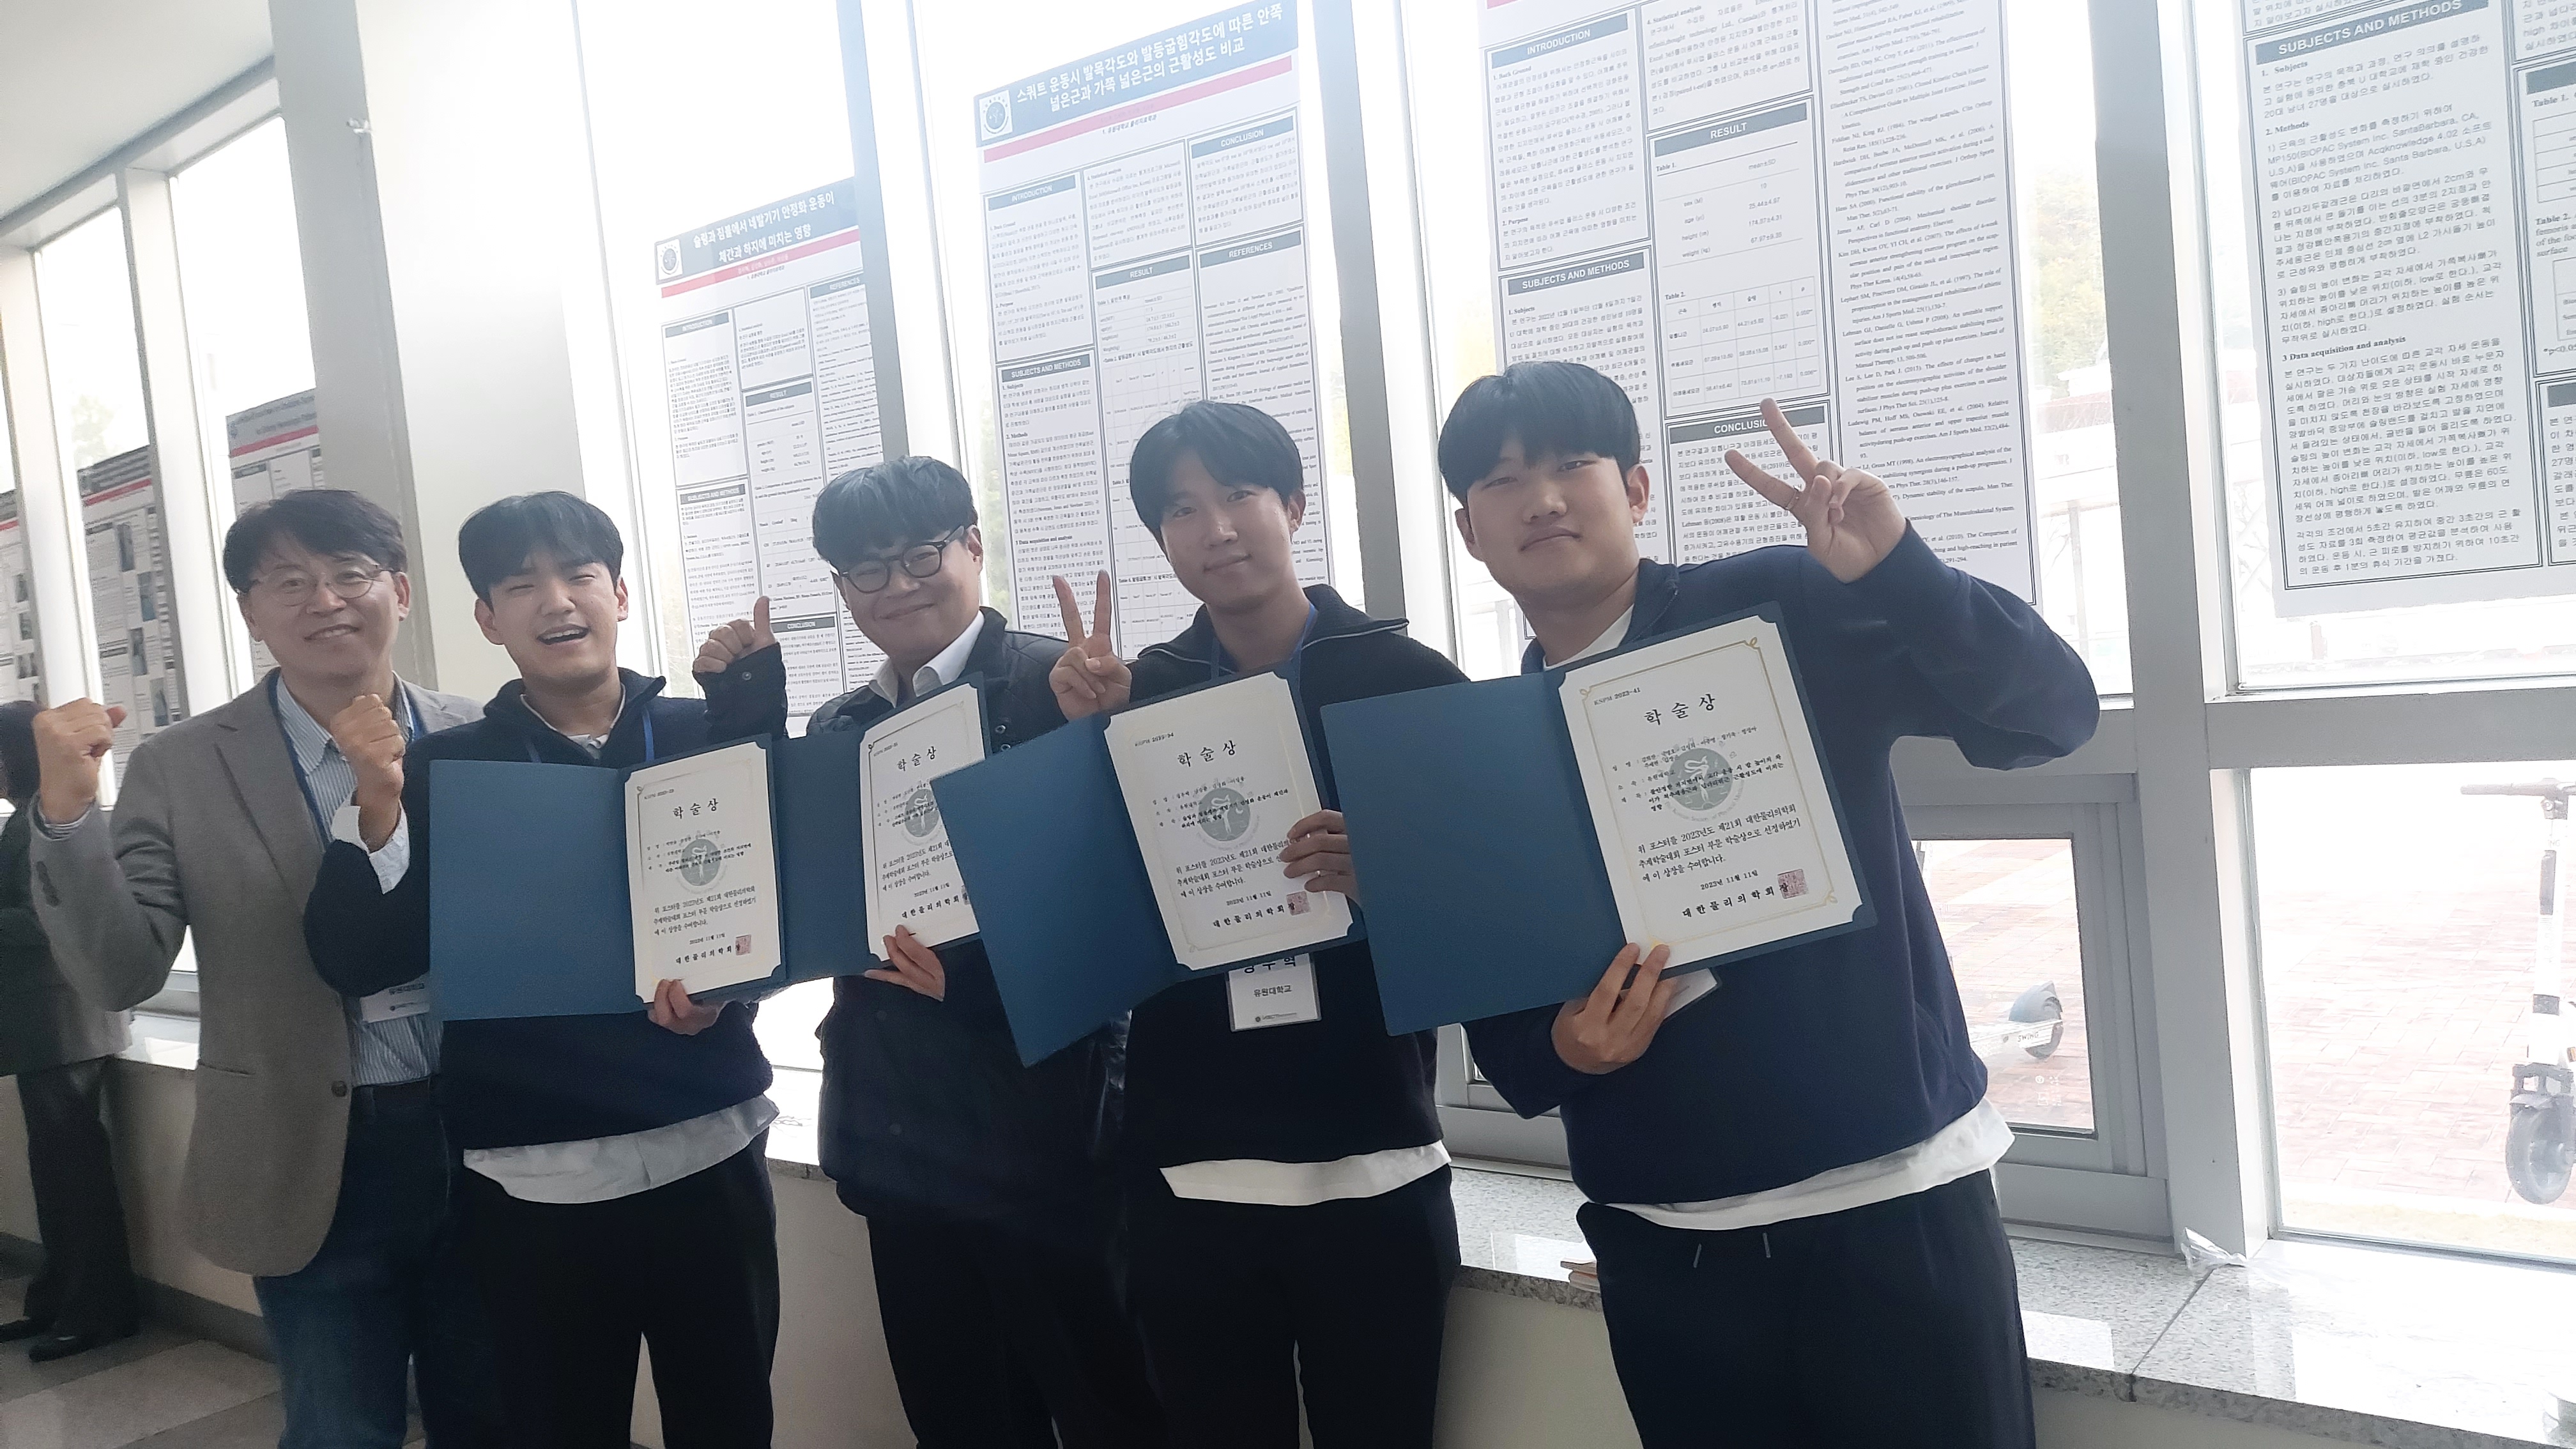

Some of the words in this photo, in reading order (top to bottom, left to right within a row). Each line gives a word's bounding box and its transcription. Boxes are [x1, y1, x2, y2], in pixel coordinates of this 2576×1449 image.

[1653, 10, 1679, 24] Statistical
[1680, 4, 1702, 15] analysis
[2278, 27, 2351, 55] SUBJECTS
[2354, 20, 2384, 37] AND
[2388, 0, 2463, 27] METHODS
[1527, 29, 1590, 54] INTRODUCTION
[1016, 81, 1047, 103] 스쿼트
[1049, 68, 1080, 93] 운동시
[1083, 50, 1138, 81] 발목각도와
[1141, 22, 1225, 62] 발등굽힘각도에
[1228, 13, 1254, 33] 따른
[1257, 3, 1282, 26] 안쪽
[1050, 84, 1091, 112] 넓은근과
[1094, 76, 1116, 95] 가쪽
[1119, 61, 1165, 89] 넓은근의
[1169, 46, 1216, 73] 근활성도
[1220, 36, 1245, 56] 비교
[2274, 61, 2308, 73] Subjects
[2533, 96, 2557, 107] Table
[1220, 128, 1264, 147] CONCLUSION
[1710, 122, 1747, 139] RESULT
[2274, 121, 2309, 134] Methods
[2337, 137, 2370, 150] System
[1655, 164, 1671, 172] Table
[2328, 165, 2361, 177] System
[2383, 154, 2409, 165] Santa
[1011, 185, 1052, 202] INTRODUCTION
[693, 229, 716, 249] 슬링과
[716, 219, 747, 240] 짐볼에서
[747, 208, 781, 229] 네발기기
[781, 199, 807, 219] 안정화
[808, 190, 834, 211] 운동이
[2536, 215, 2560, 225] Table
[718, 245, 742, 263] 체간과
[743, 236, 767, 255] 하지에
[768, 231, 792, 247] 미치는
[793, 223, 811, 240] 영향
[1229, 241, 1273, 257] REFERENCES
[1130, 266, 1153, 278] RESULT
[1522, 273, 1566, 289] SUBJECTS
[1567, 269, 1586, 280] AND
[1587, 259, 1630, 275] METHODS
[1514, 306, 1535, 314] Subjects
[2310, 345, 2354, 357] acquisition
[2356, 341, 2372, 349] and
[2373, 337, 2406, 347] analysis
[1011, 367, 1043, 378] SUBJECTS
[1041, 364, 1054, 372] AND
[1054, 358, 1081, 370] METHODS
[2296, 530, 2323, 539] 각각의
[2327, 525, 2363, 536] 조건에서
[2395, 518, 2432, 528] 유지하여
[2319, 539, 2345, 549] 자료를
[2381, 545, 2409, 555] 피로를
[2455, 538, 2484, 548] 위하여
[2394, 556, 2422, 566] 기간을
[1637, 844, 1646, 854] 위
[1649, 836, 1678, 850] 포스터를
[1680, 826, 1715, 842] 2023년도
[1717, 818, 1742, 831] 제21회
[1745, 803, 1796, 824] 대한물리의학회
[1639, 850, 1680, 868] 추계학술대회
[1683, 843, 1705, 856] 포스터
[1707, 838, 1723, 850] 부문
[1725, 829, 1762, 845] 학술상으로
[1764, 817, 1800, 835] 선정하였기
[1176, 866, 1183, 875] 위
[1184, 860, 1207, 872] 포스터를
[1209, 853, 1237, 866] 2023년도
[1239, 847, 1258, 858] 제21회
[1642, 873, 1650, 882] 에
[1652, 870, 1660, 880] 이
[1663, 864, 1685, 877] 상장을
[1687, 854, 1726, 871] 수여합니다.
[1177, 872, 1210, 887] 추계학술대회
[1211, 867, 1229, 878] 포스터
[1230, 864, 1243, 873] 부문
[1245, 856, 1274, 870] 학술상으로
[1700, 878, 1723, 890] 2023년
[1726, 874, 1741, 884] 11월
[1743, 869, 1758, 878] 11일
[1188, 888, 1195, 896] 이
[1197, 884, 1213, 895] 상장을
[1215, 877, 1245, 890] 수여합니다.
[1254, 985, 1292, 998] 유원대학교
